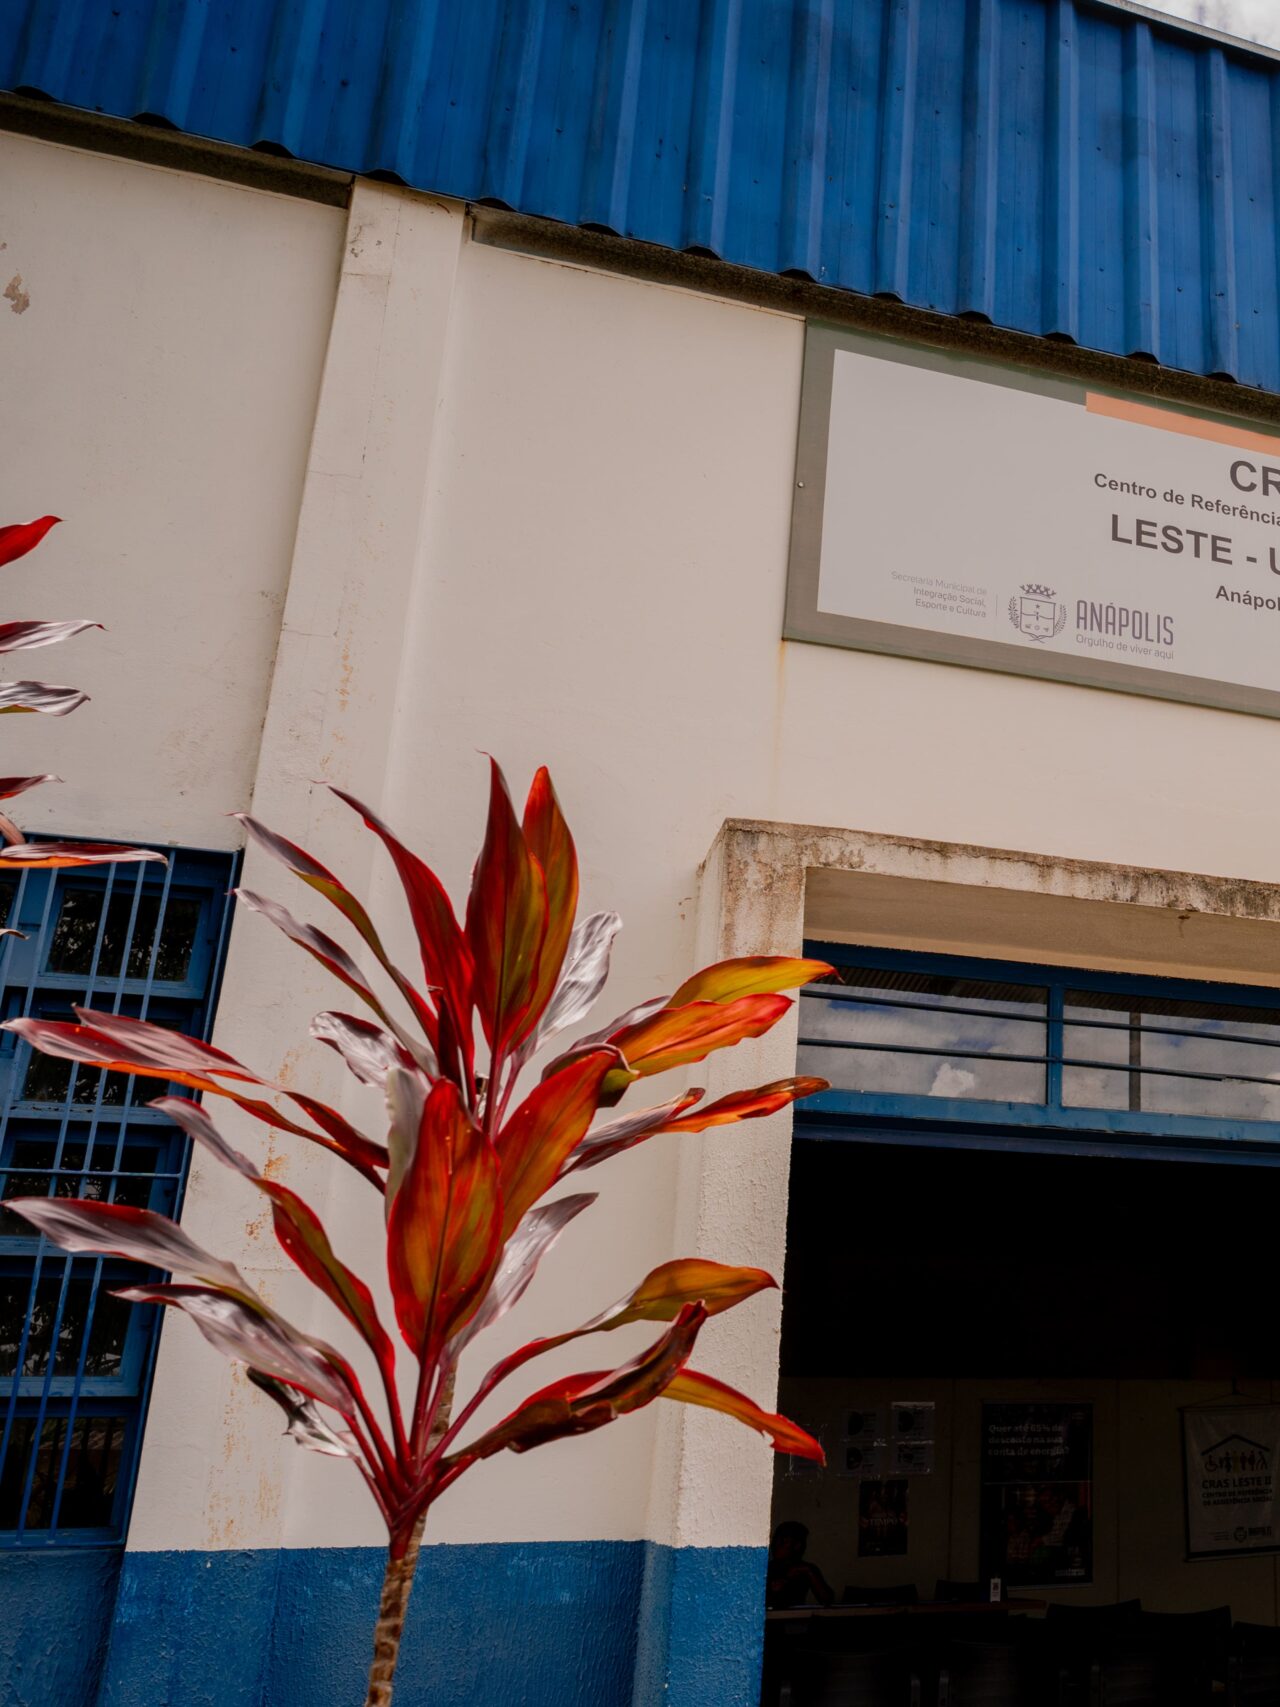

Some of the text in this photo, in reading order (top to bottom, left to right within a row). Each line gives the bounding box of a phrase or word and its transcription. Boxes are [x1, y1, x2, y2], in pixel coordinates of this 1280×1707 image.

[1094, 473, 1157, 499] Centro
[1163, 489, 1185, 505] de
[1111, 513, 1233, 565] LESTE
[915, 598, 948, 612] Esporte
[956, 605, 987, 618] Cultura
[1076, 599, 1174, 646] ANÁPOLIS
[1076, 633, 1174, 661] Orgulho de viver aqui
[1202, 1478, 1229, 1489] CRAS
[1232, 1476, 1262, 1488] LESTE
